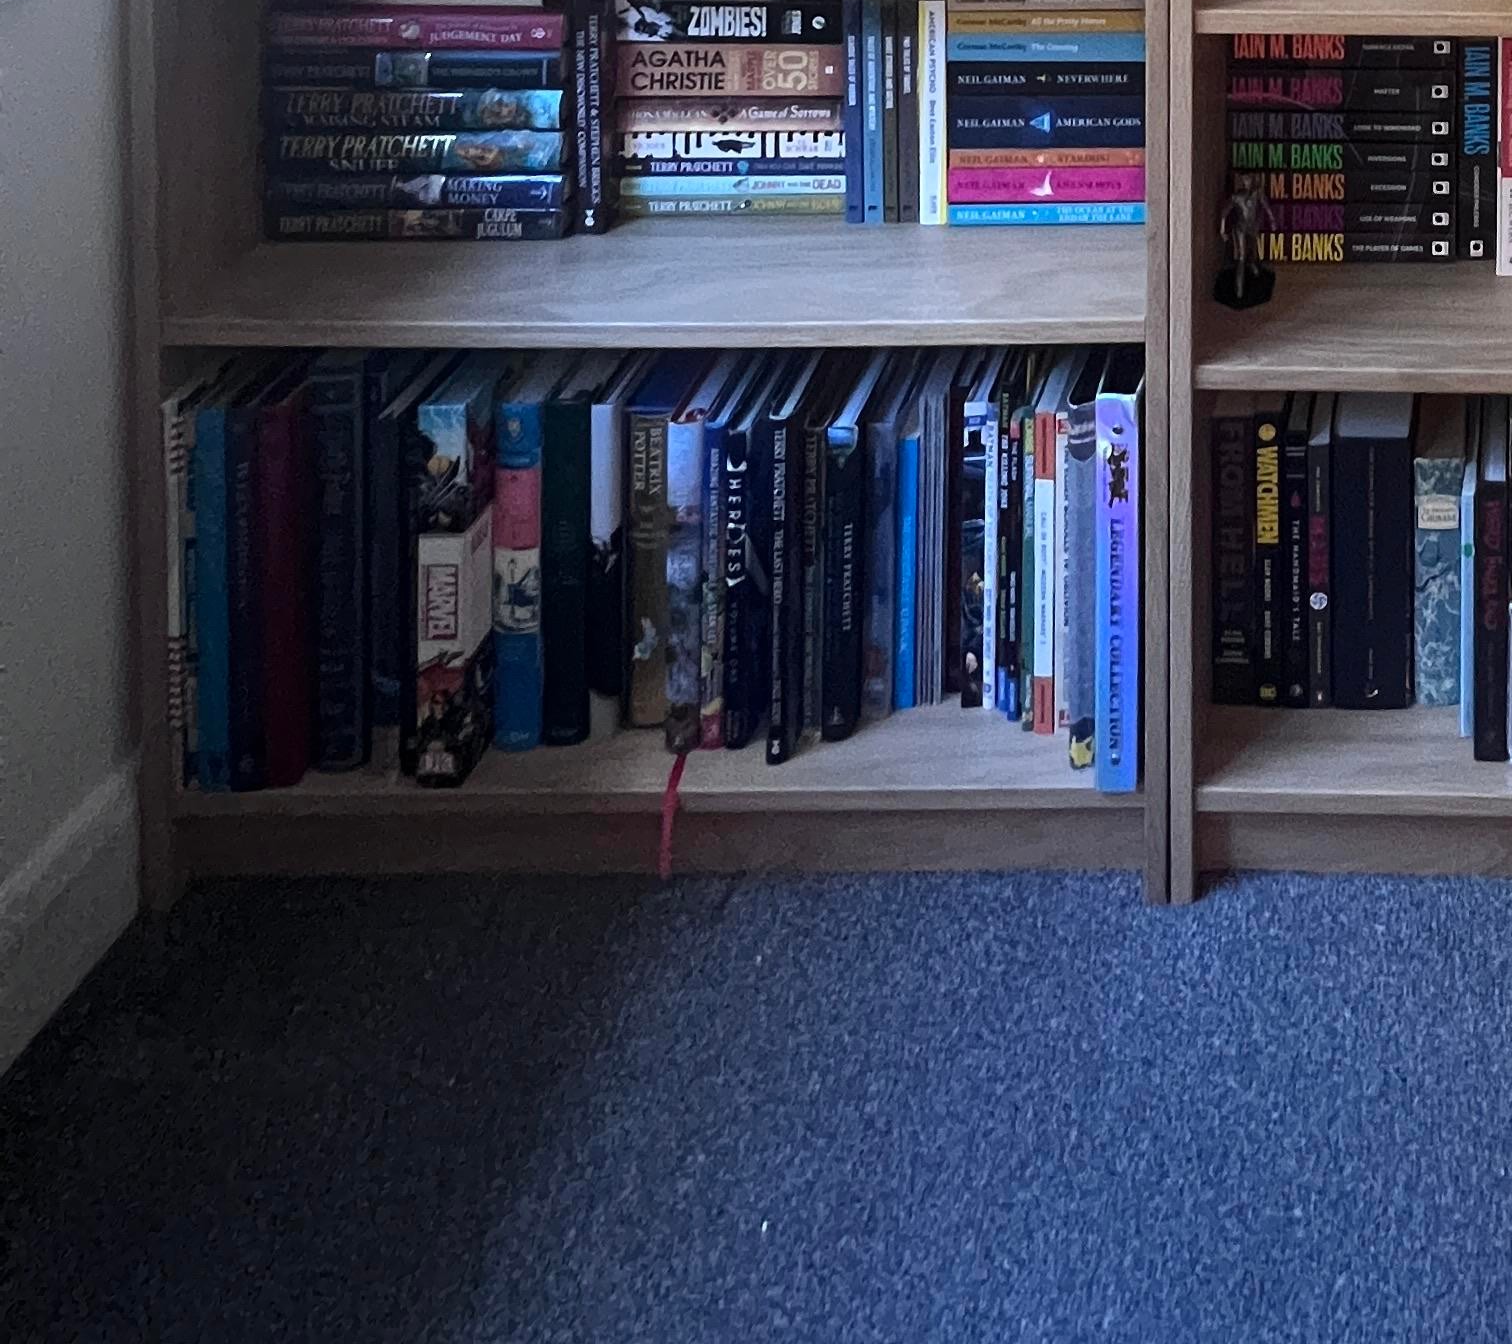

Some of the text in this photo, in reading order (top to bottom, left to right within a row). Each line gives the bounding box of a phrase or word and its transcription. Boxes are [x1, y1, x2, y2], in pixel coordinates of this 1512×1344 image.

[688, 7, 767, 37] ZOMBIES!
[631, 51, 725, 68] AGATHA
[778, 51, 808, 91] 50
[631, 74, 725, 90] CHRISTIE
[957, 74, 1129, 83] NEIL GAIMAN NEVERWHERE
[1232, 144, 1343, 169] IAIN M. BANKS
[1257, 446, 1278, 544] WATCHMEN
